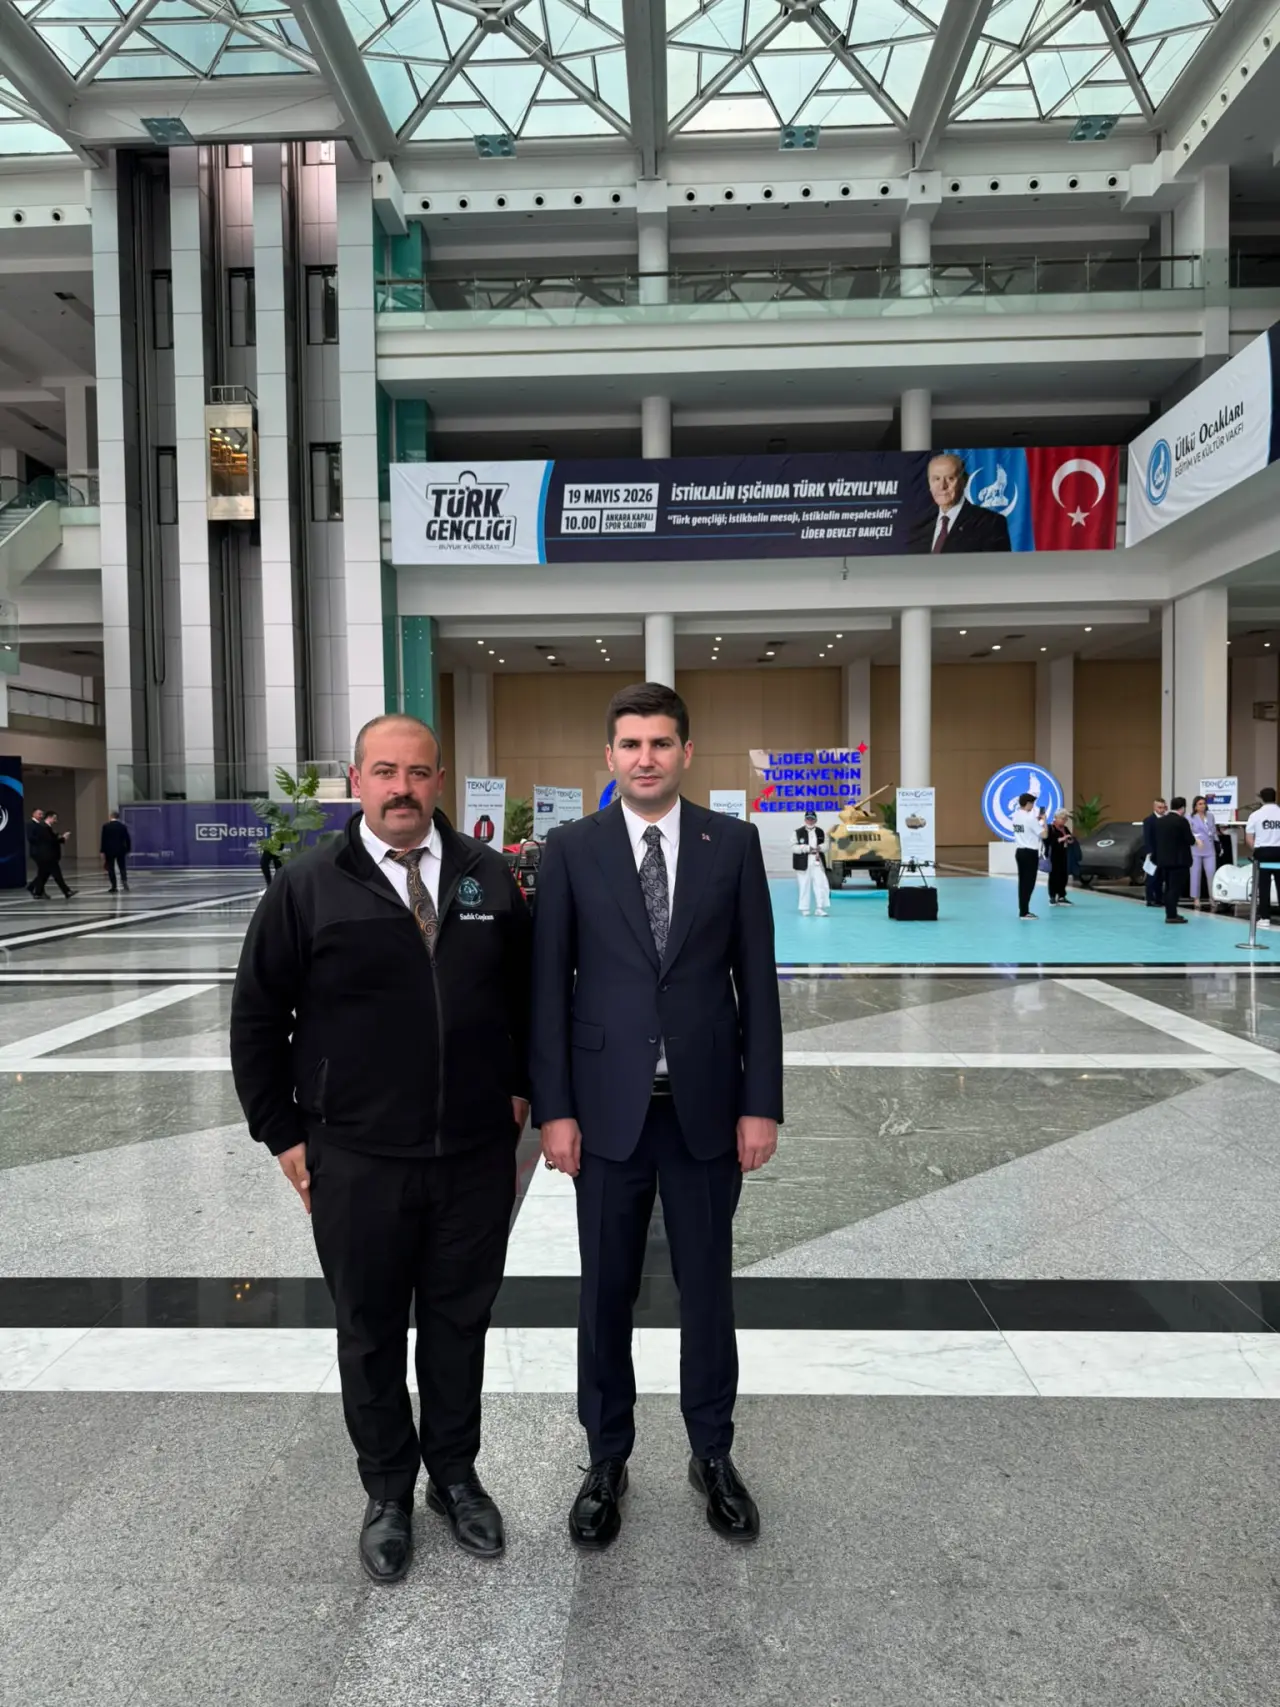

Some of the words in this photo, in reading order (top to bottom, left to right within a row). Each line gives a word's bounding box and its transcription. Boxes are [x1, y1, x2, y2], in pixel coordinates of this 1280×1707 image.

[1193, 452, 1201, 465] VE
[1202, 435, 1225, 460] KÜLTÜR
[1225, 421, 1244, 443] VAKFI
[568, 489, 581, 504] 19
[584, 488, 621, 503] MAYIS
[622, 488, 653, 503] 2026
[671, 482, 735, 501] İSTİKLALİN
[737, 481, 790, 502] IŞIĞINDA
[793, 480, 825, 498] TÜRK
[828, 478, 899, 497] YÜZYILI'NA!
[431, 487, 504, 518] TÜRK
[565, 515, 597, 530] 10.00
[605, 513, 630, 521] ANKARA
[631, 512, 654, 521] KAPALI
[691, 513, 728, 526] gençliği;
[769, 511, 801, 524] mesajı,
[426, 517, 512, 543] GENÇLİĞİ
[605, 521, 622, 530] SPOR
[622, 521, 647, 529] SALONU
[801, 526, 825, 539] LİDER
[826, 526, 857, 538] DEVLET
[858, 524, 893, 540] BAHÇELİ
[768, 751, 815, 766] LİDER
[819, 749, 861, 765] ÜLKE
[763, 767, 861, 781] TÜRKİYE'NİN
[774, 783, 861, 797] TEKNOLOJİ
